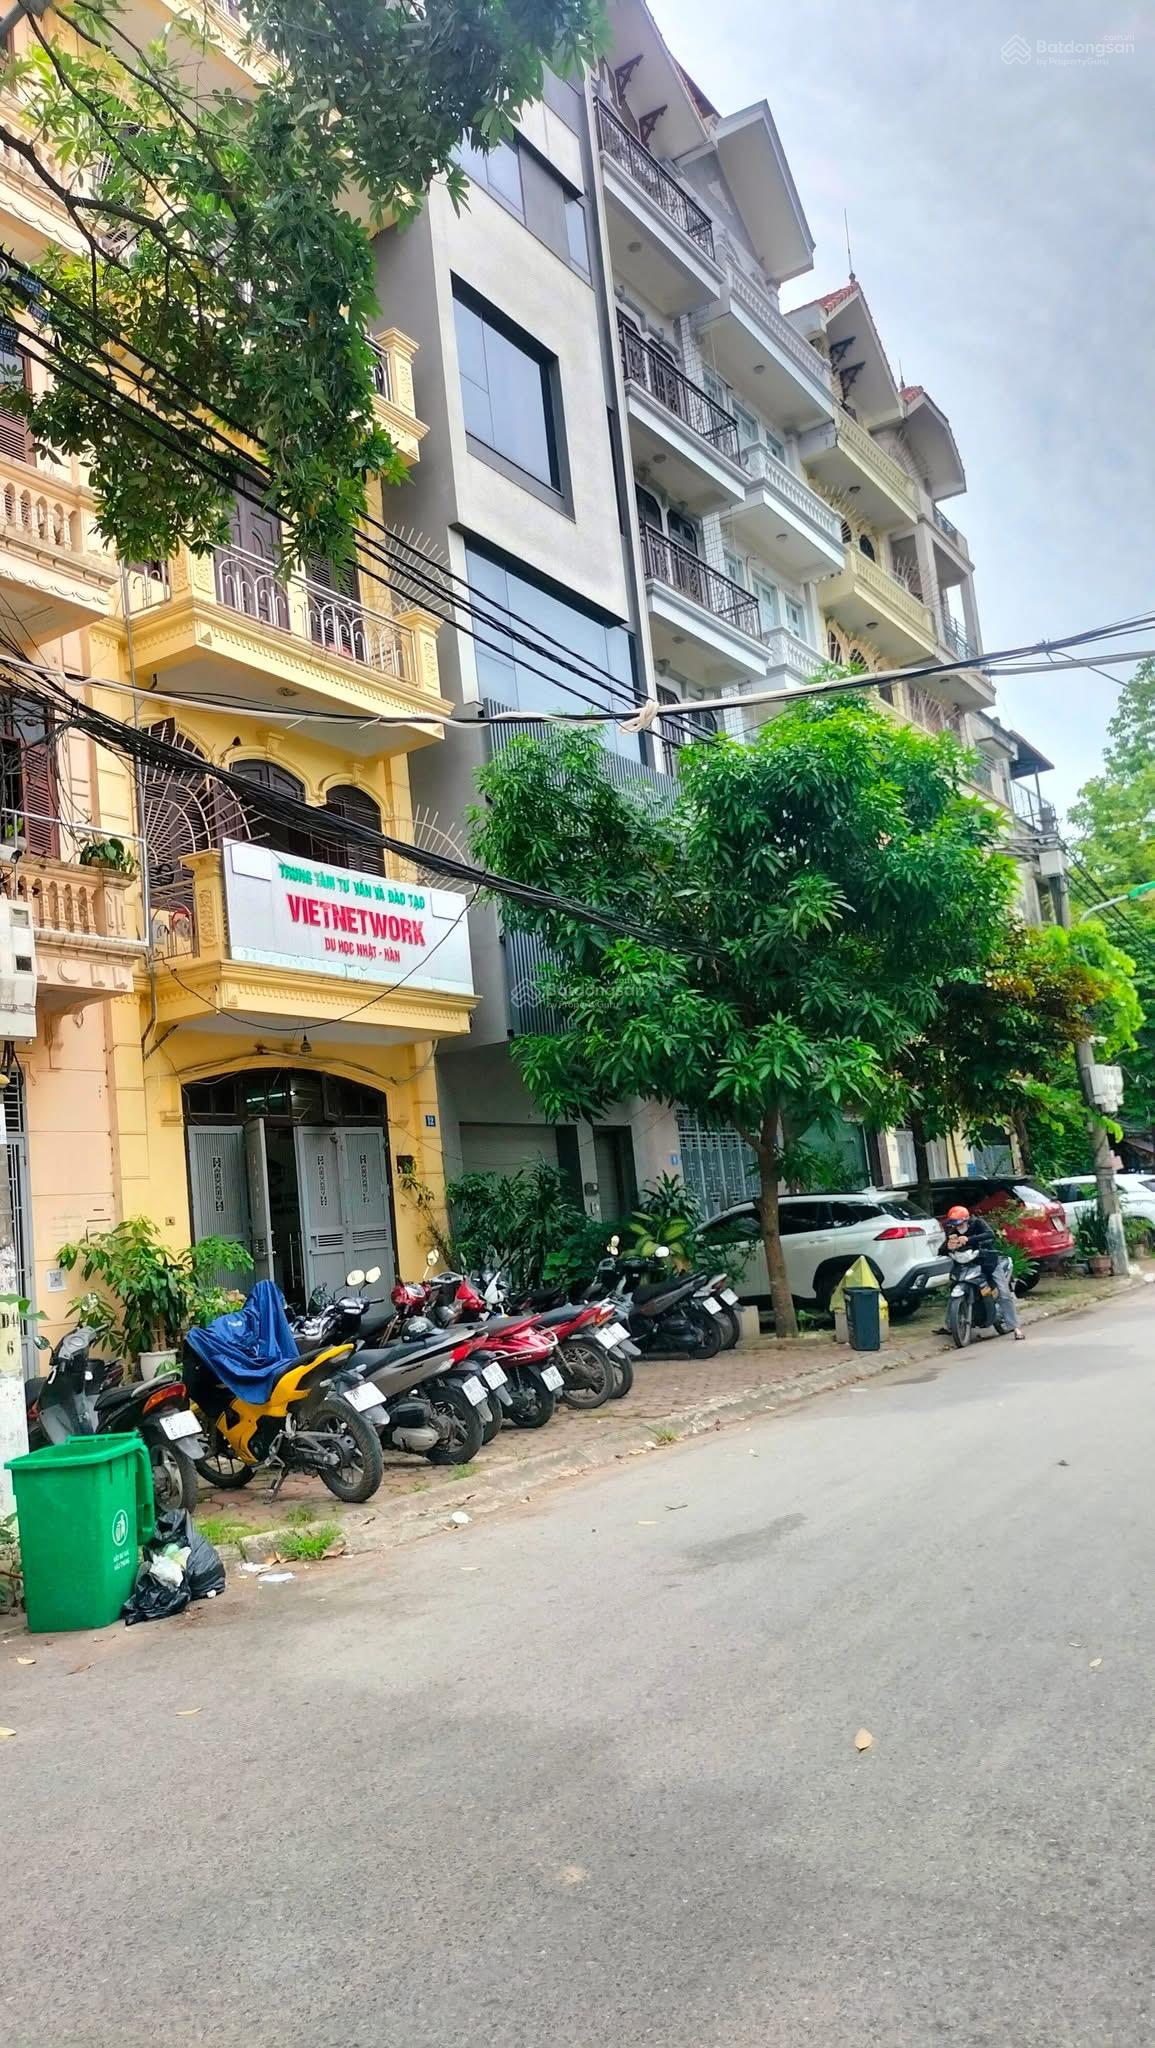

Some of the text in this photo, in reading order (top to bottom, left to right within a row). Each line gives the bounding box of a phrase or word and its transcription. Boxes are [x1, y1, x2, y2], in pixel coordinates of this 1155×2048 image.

[278, 863, 312, 885] TRUNG
[407, 893, 425, 910] TẠO
[287, 893, 425, 947] VIETNETWORK
[324, 937, 336, 952] DU
[337, 939, 355, 957] HỌC
[383, 946, 400, 963] HÀN
[426, 1116, 435, 1126] 12
[7, 1340, 14, 1356] 6
